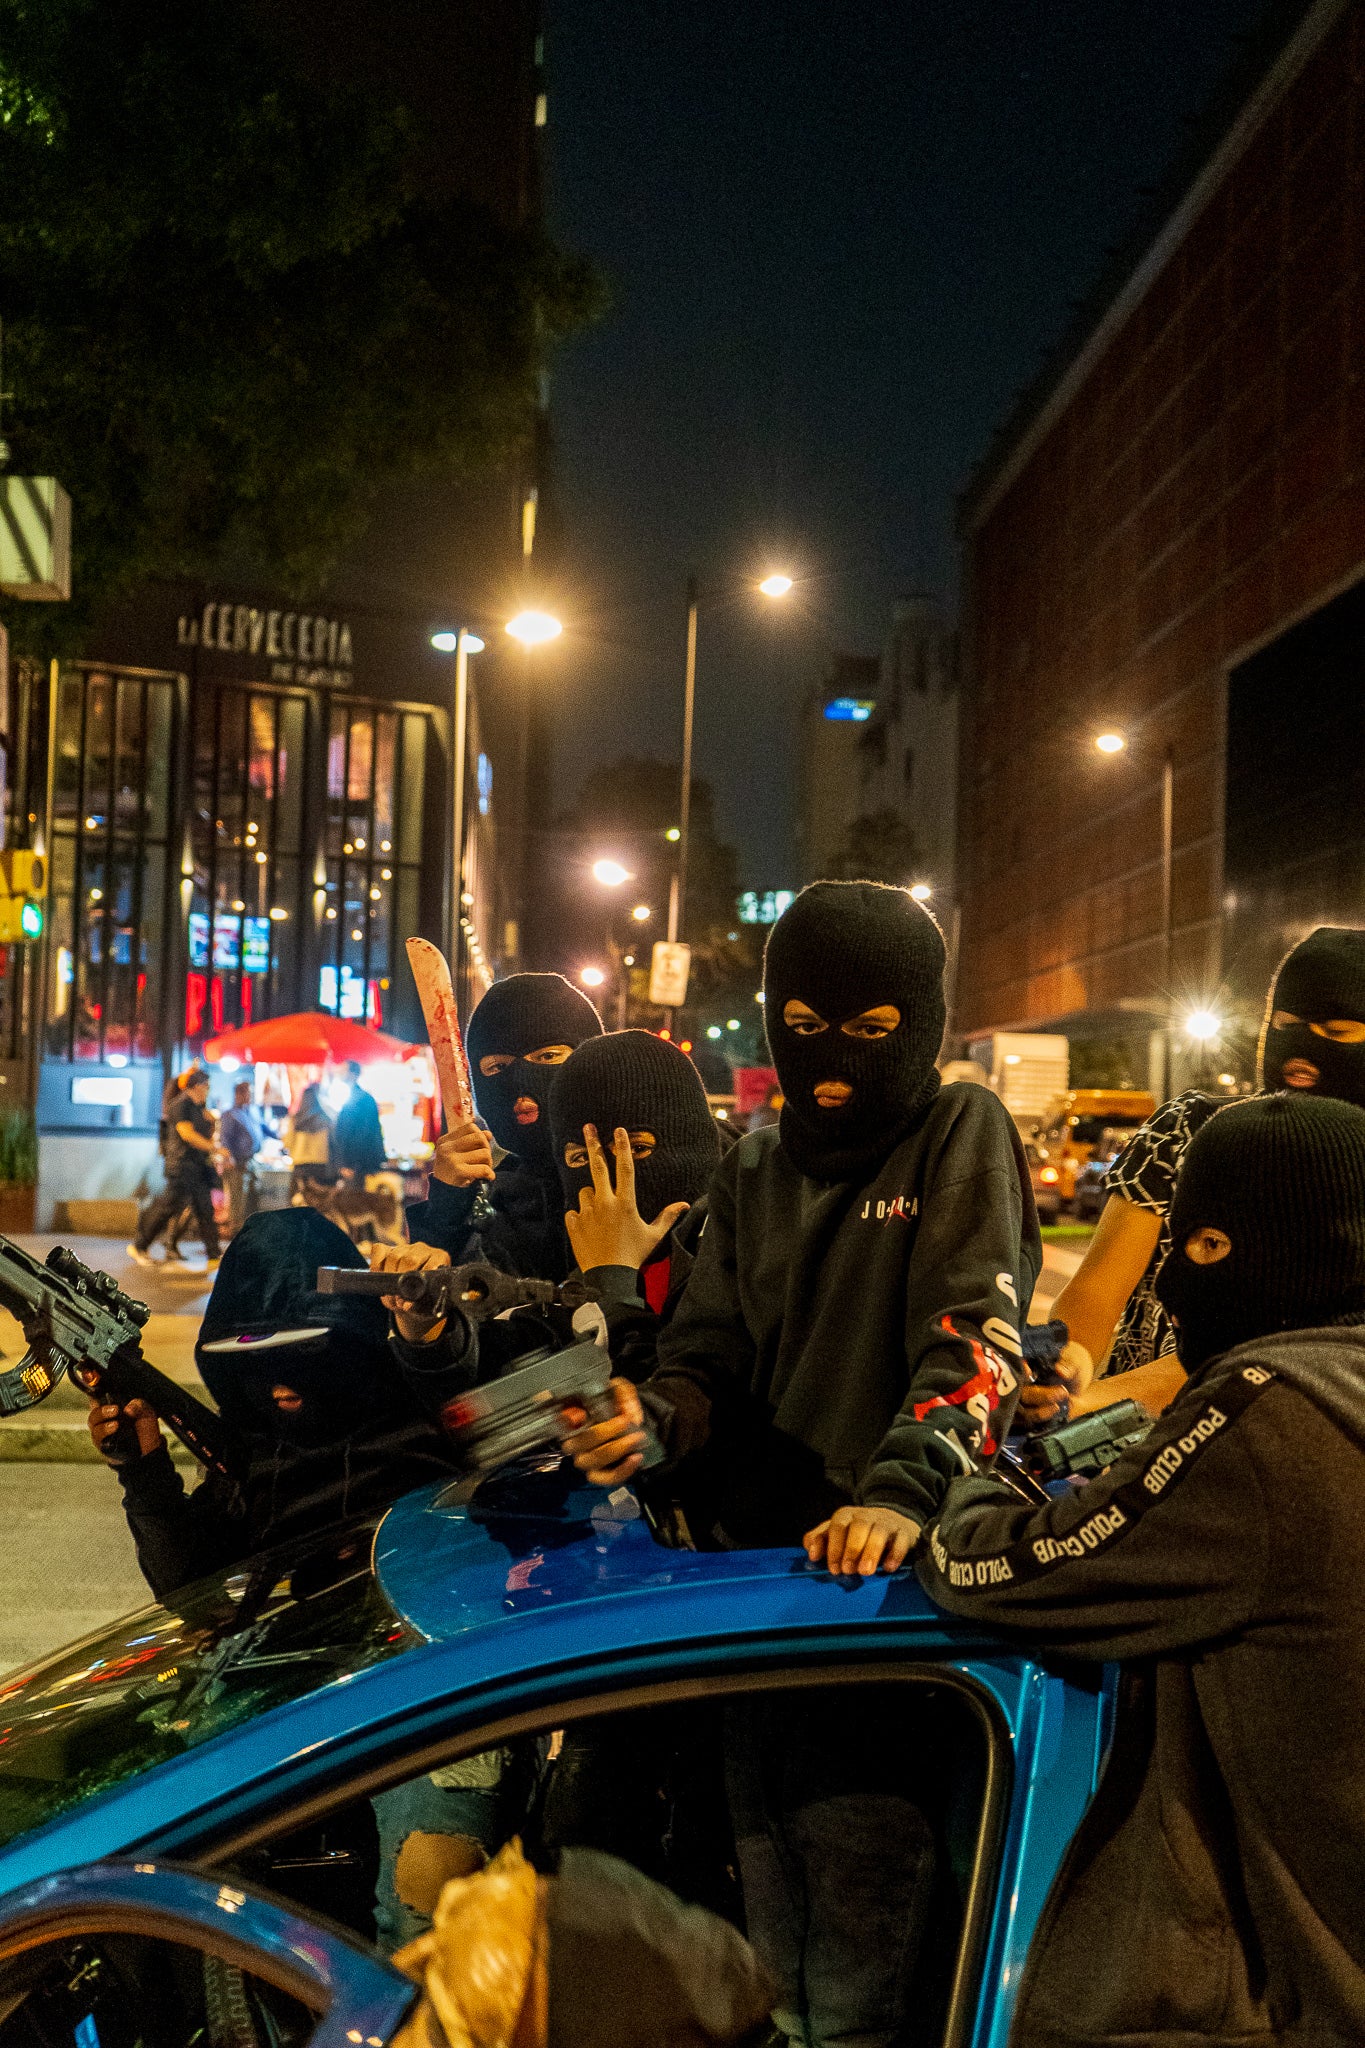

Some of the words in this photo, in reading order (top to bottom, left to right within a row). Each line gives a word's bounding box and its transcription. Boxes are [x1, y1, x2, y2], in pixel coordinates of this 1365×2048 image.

[1178, 1405, 1228, 1454] POLO
[1143, 1446, 1183, 1495] CLUB
[1079, 1504, 1128, 1549] POLO
[976, 1556, 1013, 1585] POLO
[1032, 1535, 1085, 1564] CLUB
